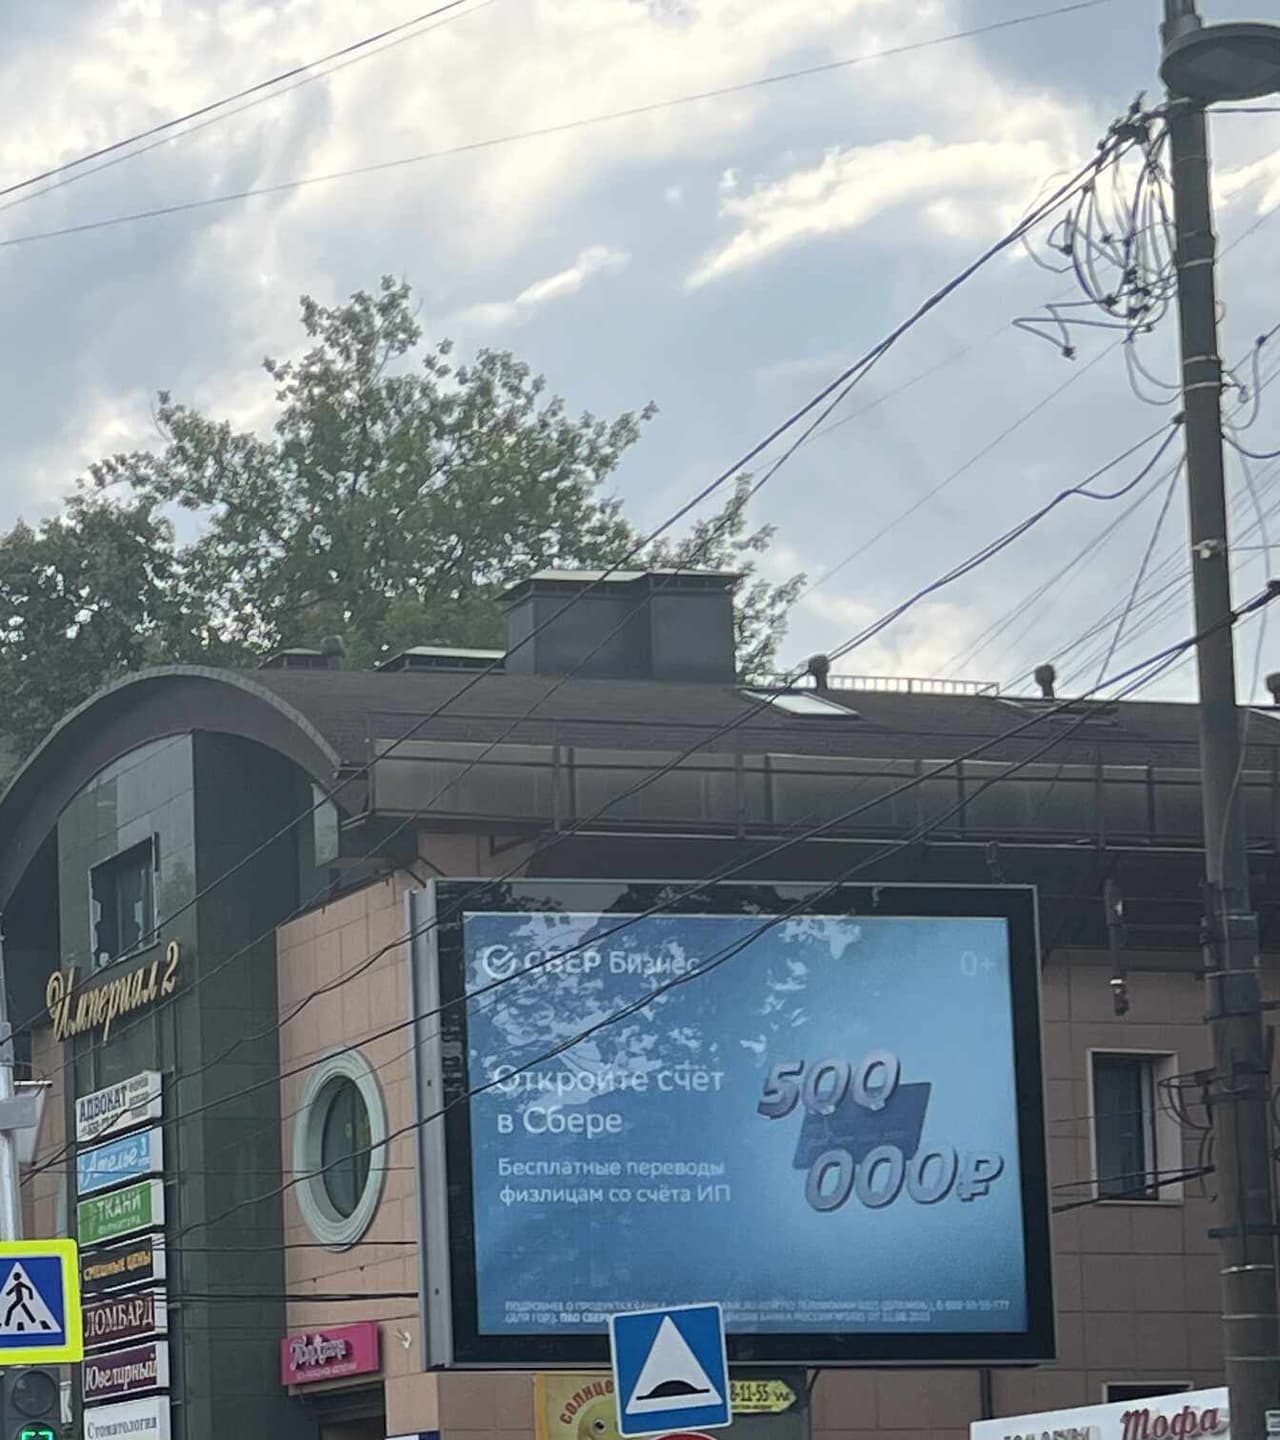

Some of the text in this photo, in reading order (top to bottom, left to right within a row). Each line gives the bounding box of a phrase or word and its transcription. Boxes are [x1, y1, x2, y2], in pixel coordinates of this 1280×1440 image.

[160, 940, 179, 996] 2
[609, 949, 700, 975] Бизнес
[757, 1049, 901, 1120] 500
[80, 1085, 128, 1123] АДВОКАТ
[497, 1105, 623, 1139] в Сбере
[497, 1157, 725, 1179] Бесплатные переводы
[499, 1183, 731, 1206] физлицам со счёта ИП
[84, 1295, 154, 1338] ЛОМБАРД
[85, 1352, 158, 1391] Ювелирный
[86, 1416, 158, 1440] Стоматология
